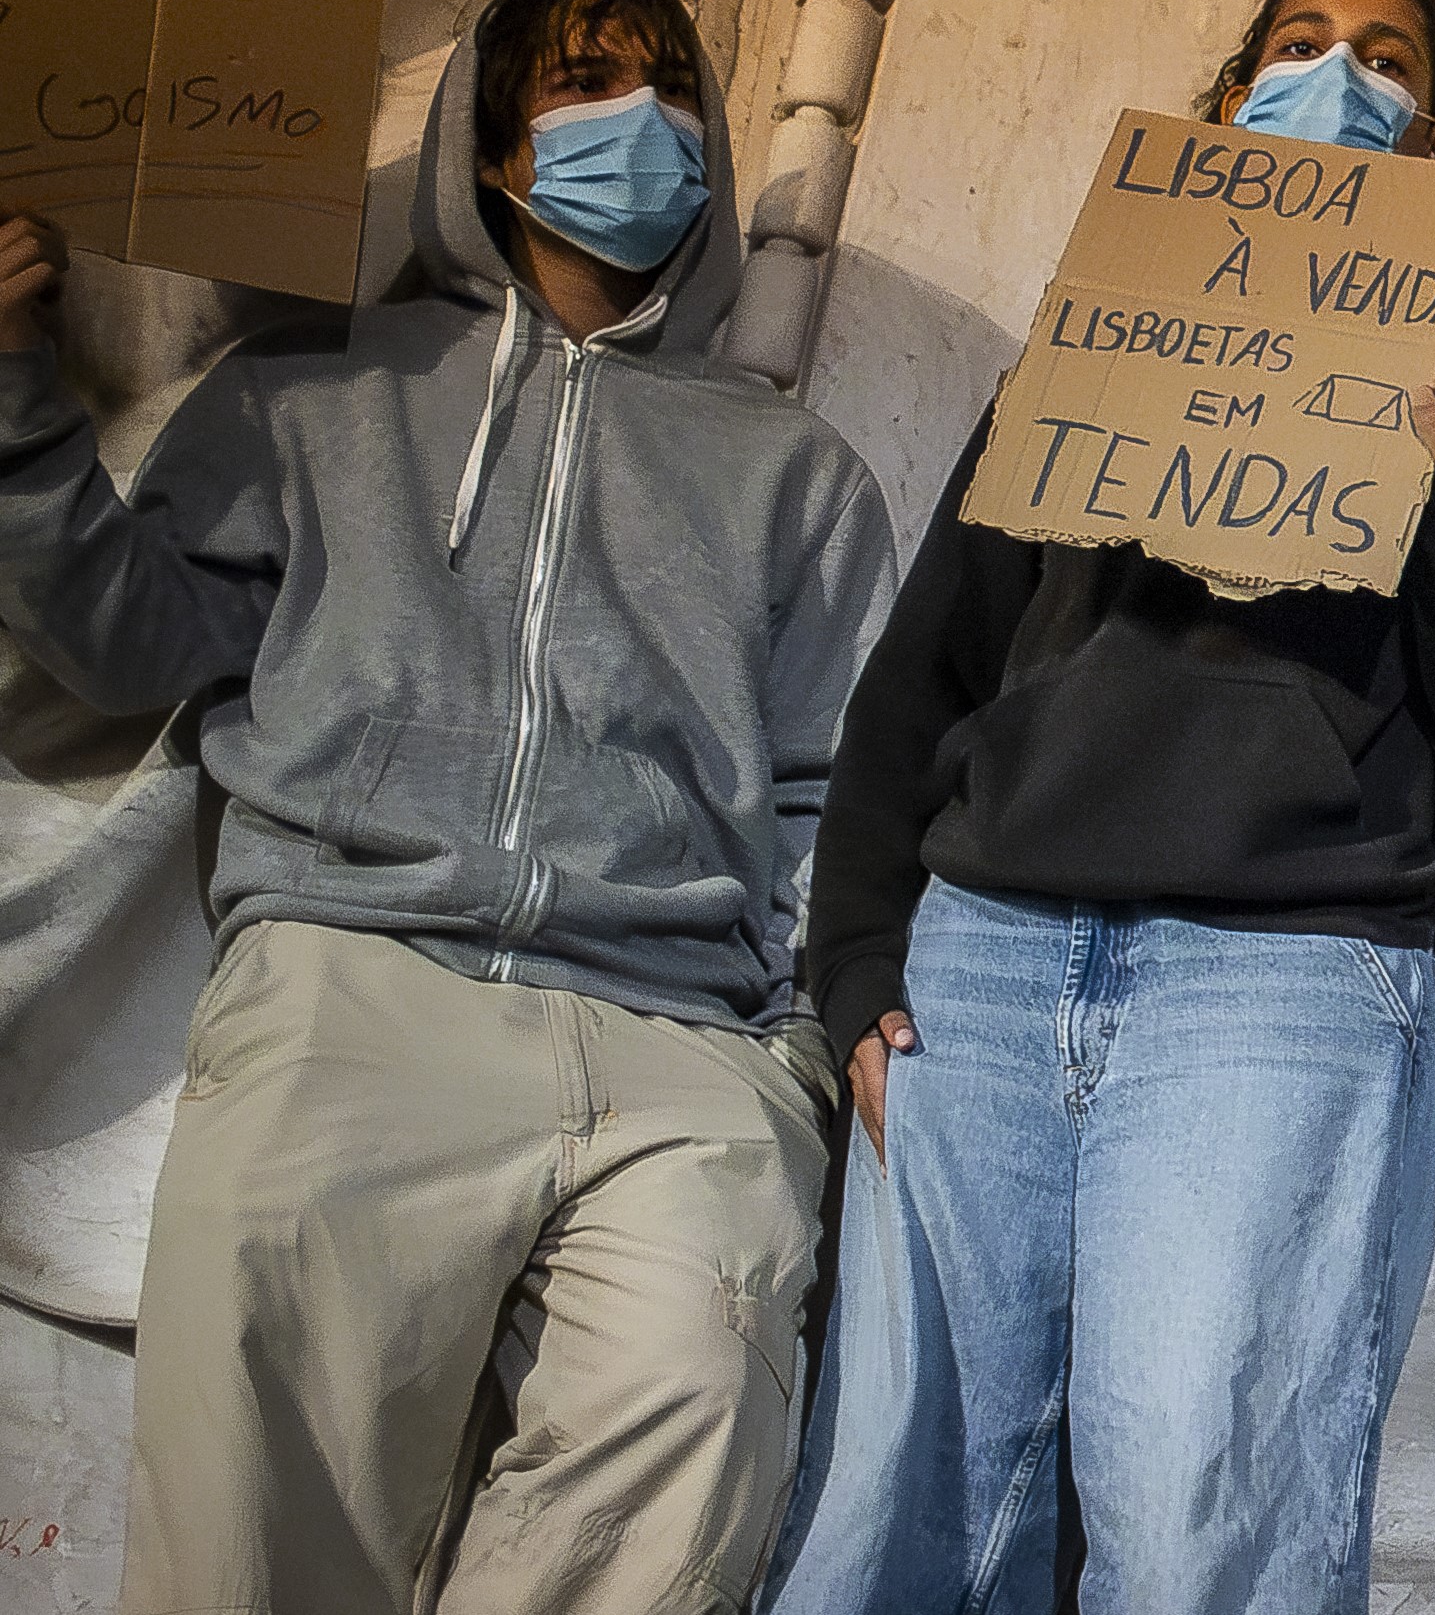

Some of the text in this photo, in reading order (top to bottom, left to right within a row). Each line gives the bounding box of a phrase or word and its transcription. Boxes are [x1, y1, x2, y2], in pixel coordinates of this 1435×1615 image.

[0, 74, 323, 156] GOISMO
[1113, 128, 1371, 226] LISBOA
[1203, 218, 1253, 296] À
[1050, 299, 1295, 373] LISBOETAS
[1184, 390, 1266, 427] EM
[1030, 418, 1378, 554] TENDAS
